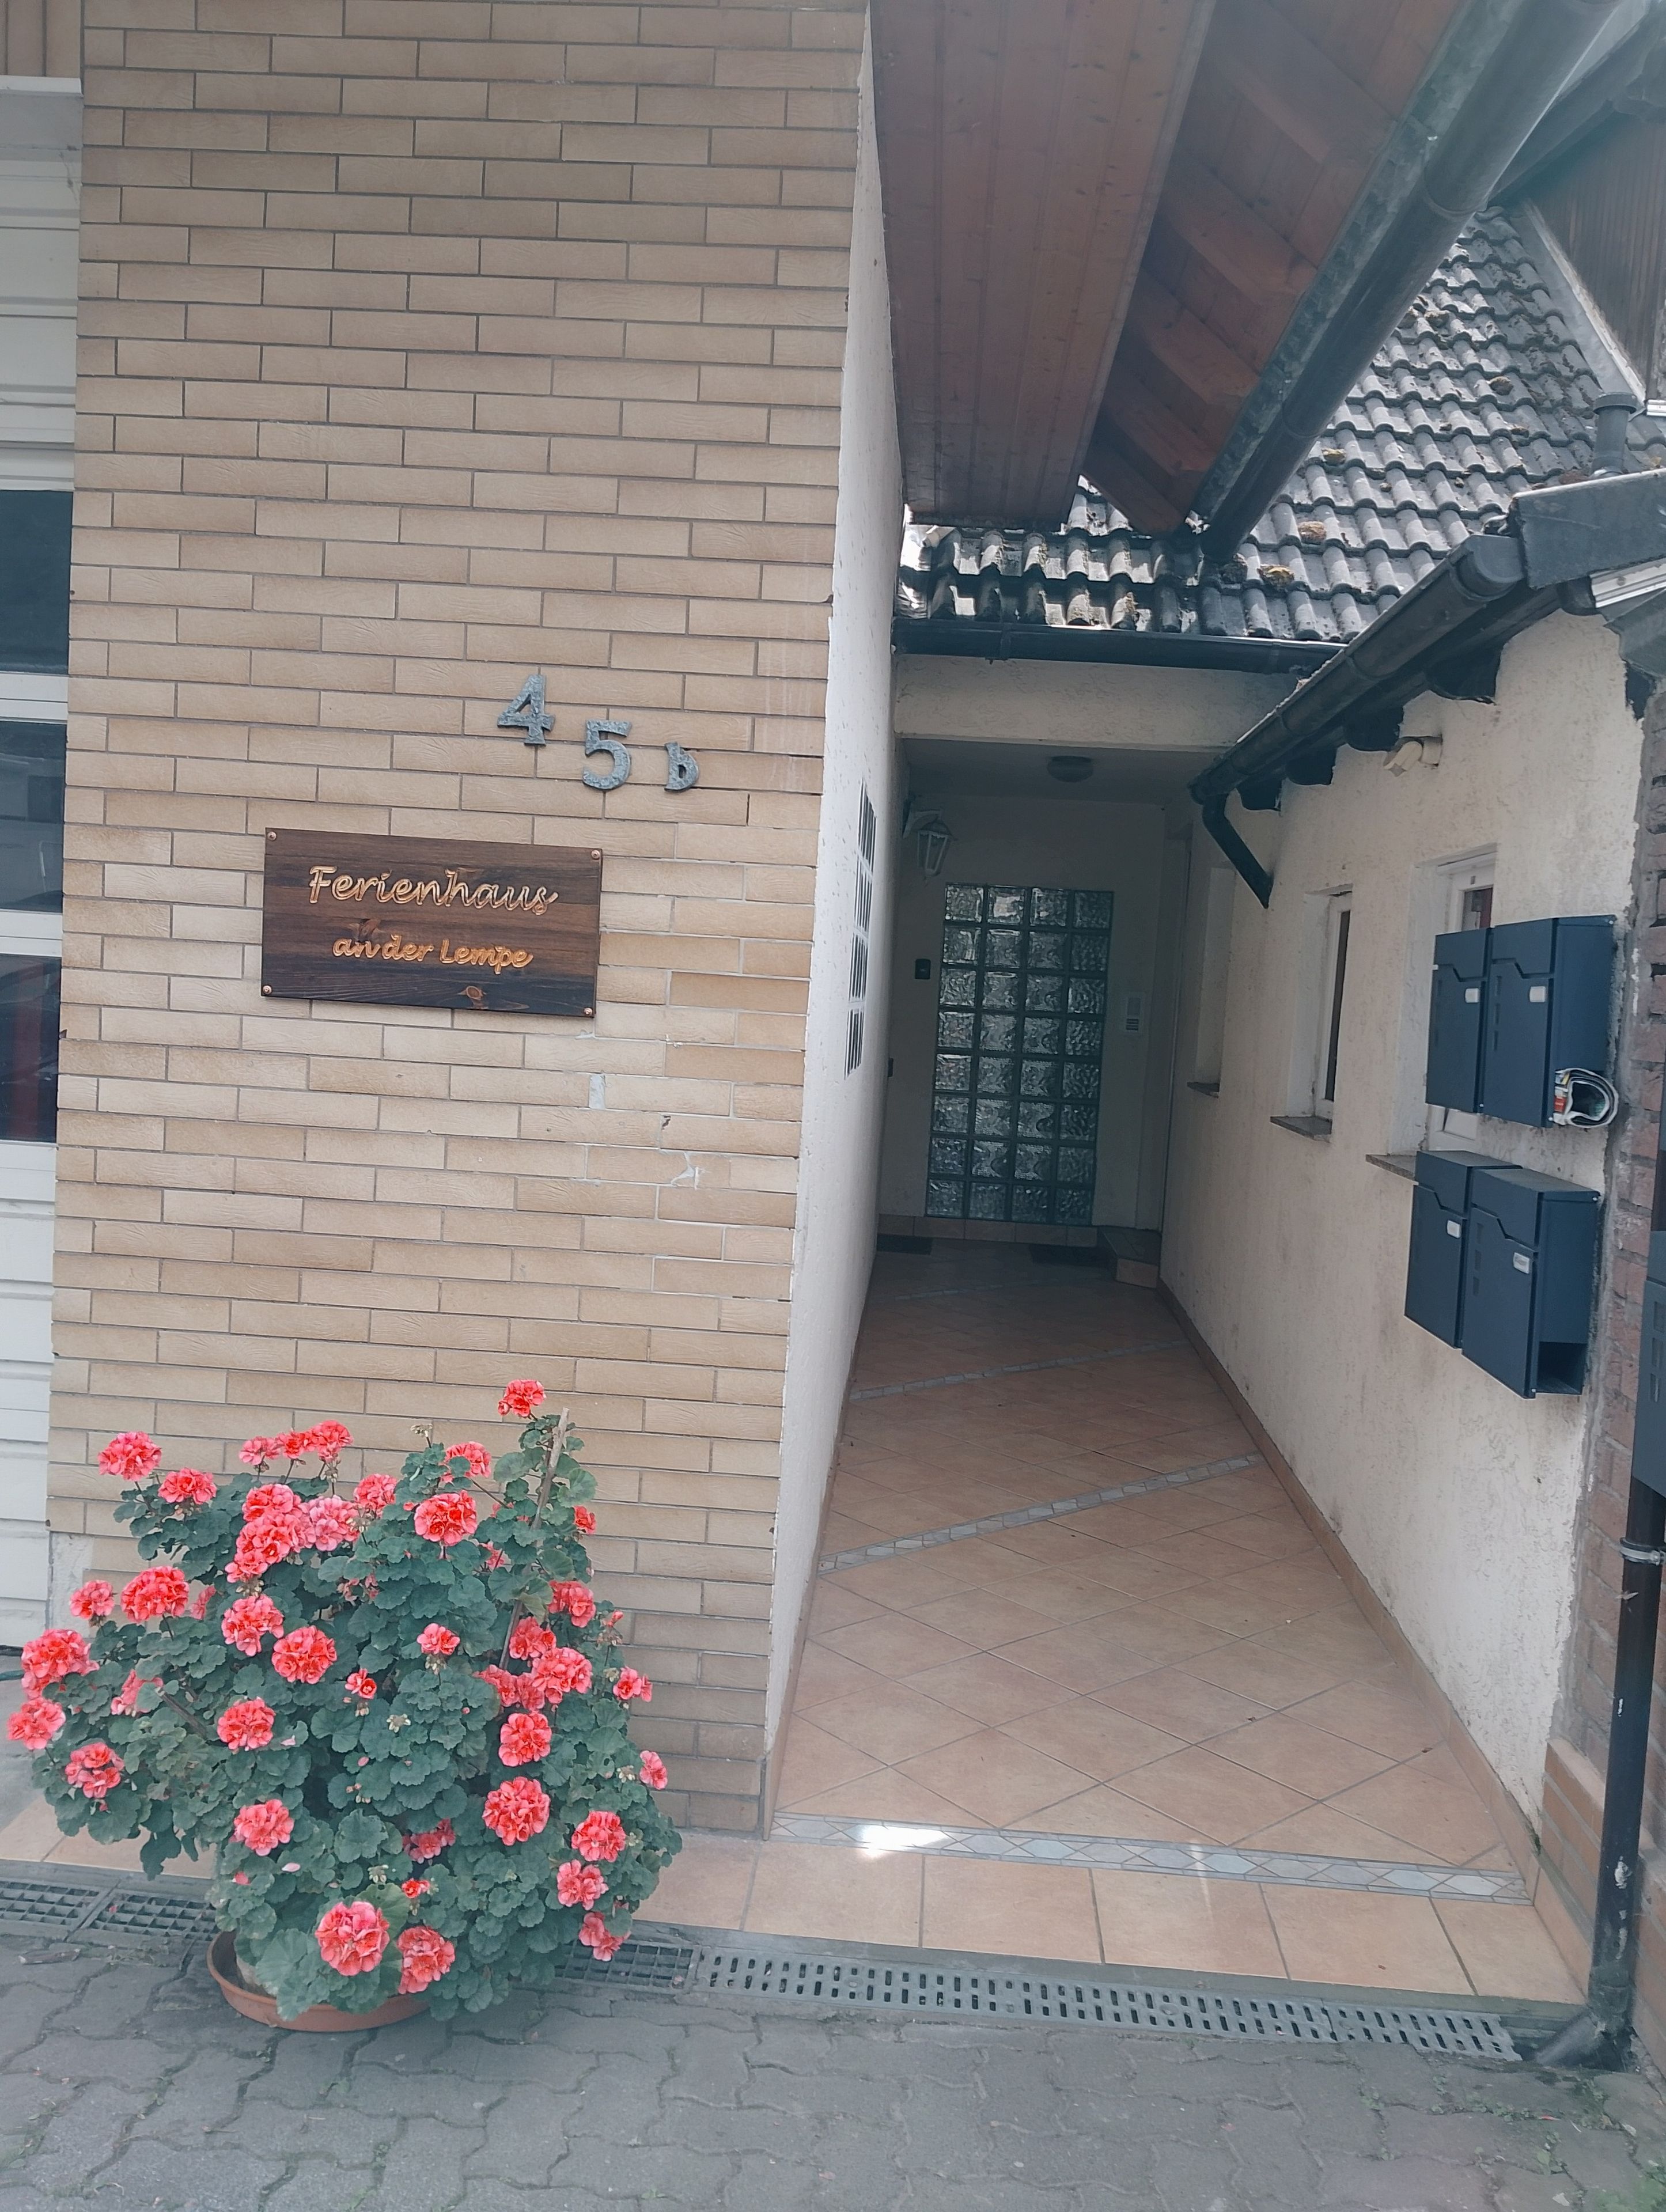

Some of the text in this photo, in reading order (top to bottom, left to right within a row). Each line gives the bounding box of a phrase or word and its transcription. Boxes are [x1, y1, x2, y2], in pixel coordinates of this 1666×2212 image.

[308, 865, 558, 915] Ferienhaus
[332, 933, 533, 975] an der Lempe
